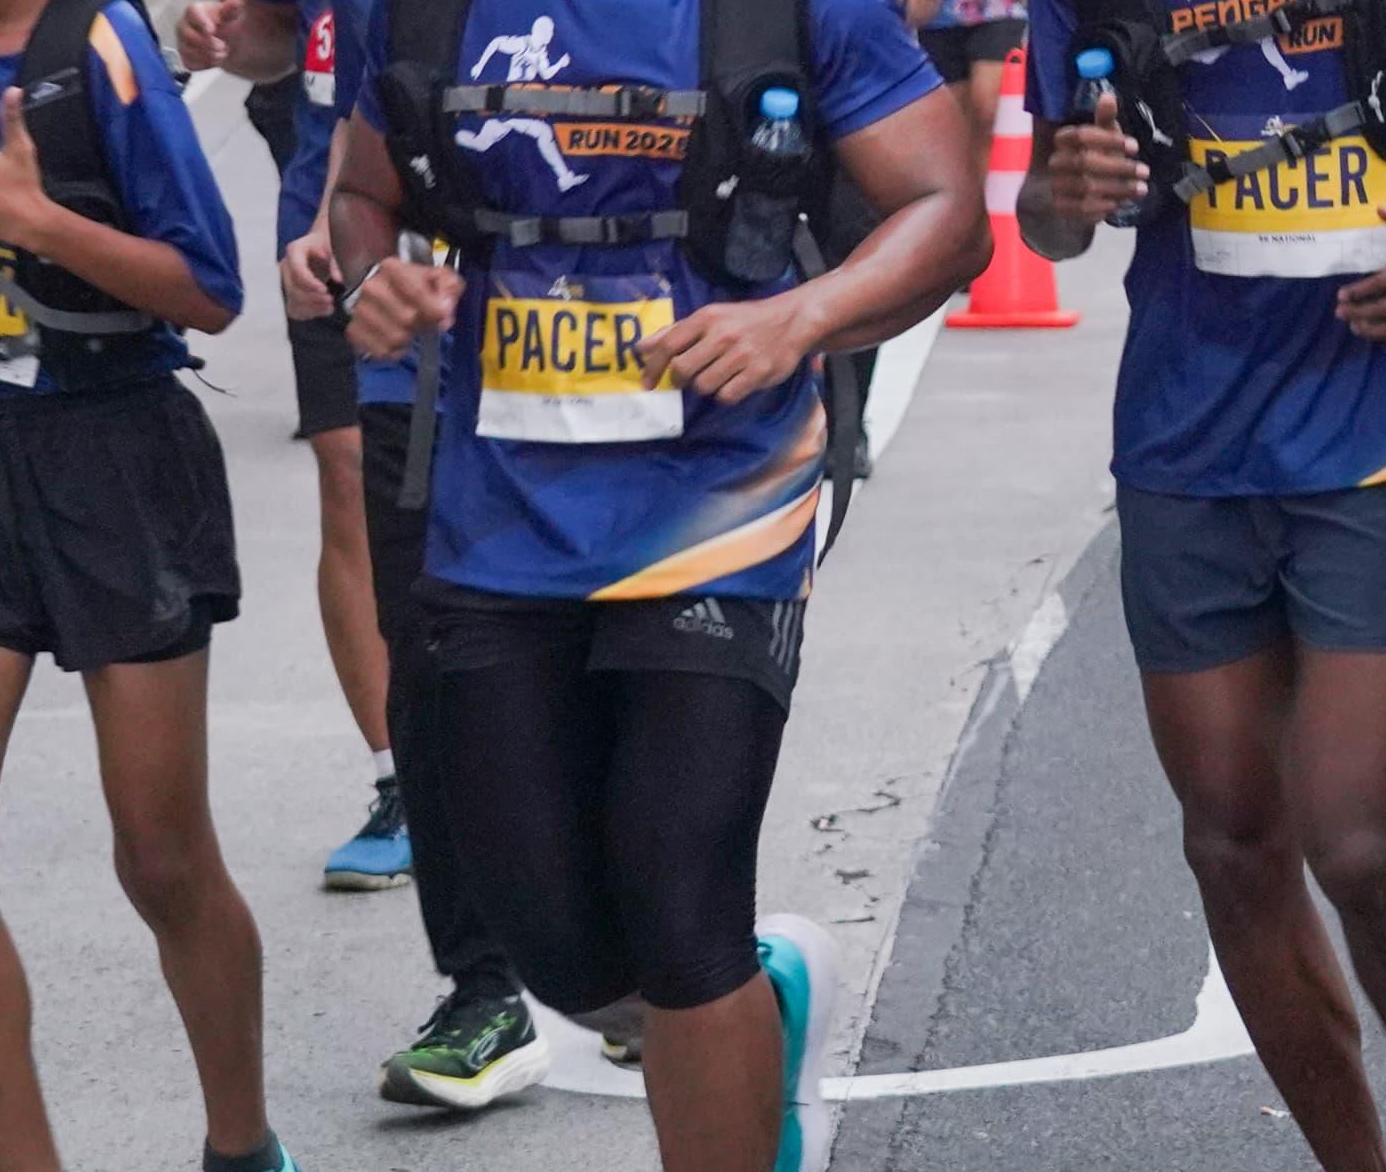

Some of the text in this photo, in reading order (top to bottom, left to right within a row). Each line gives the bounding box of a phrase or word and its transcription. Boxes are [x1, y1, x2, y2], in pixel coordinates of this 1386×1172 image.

[1288, 23, 1337, 49] RUN
[567, 129, 621, 151] RUN
[1203, 145, 1370, 212] PACER
[495, 308, 646, 373] PACER
[672, 616, 735, 640] adidas
